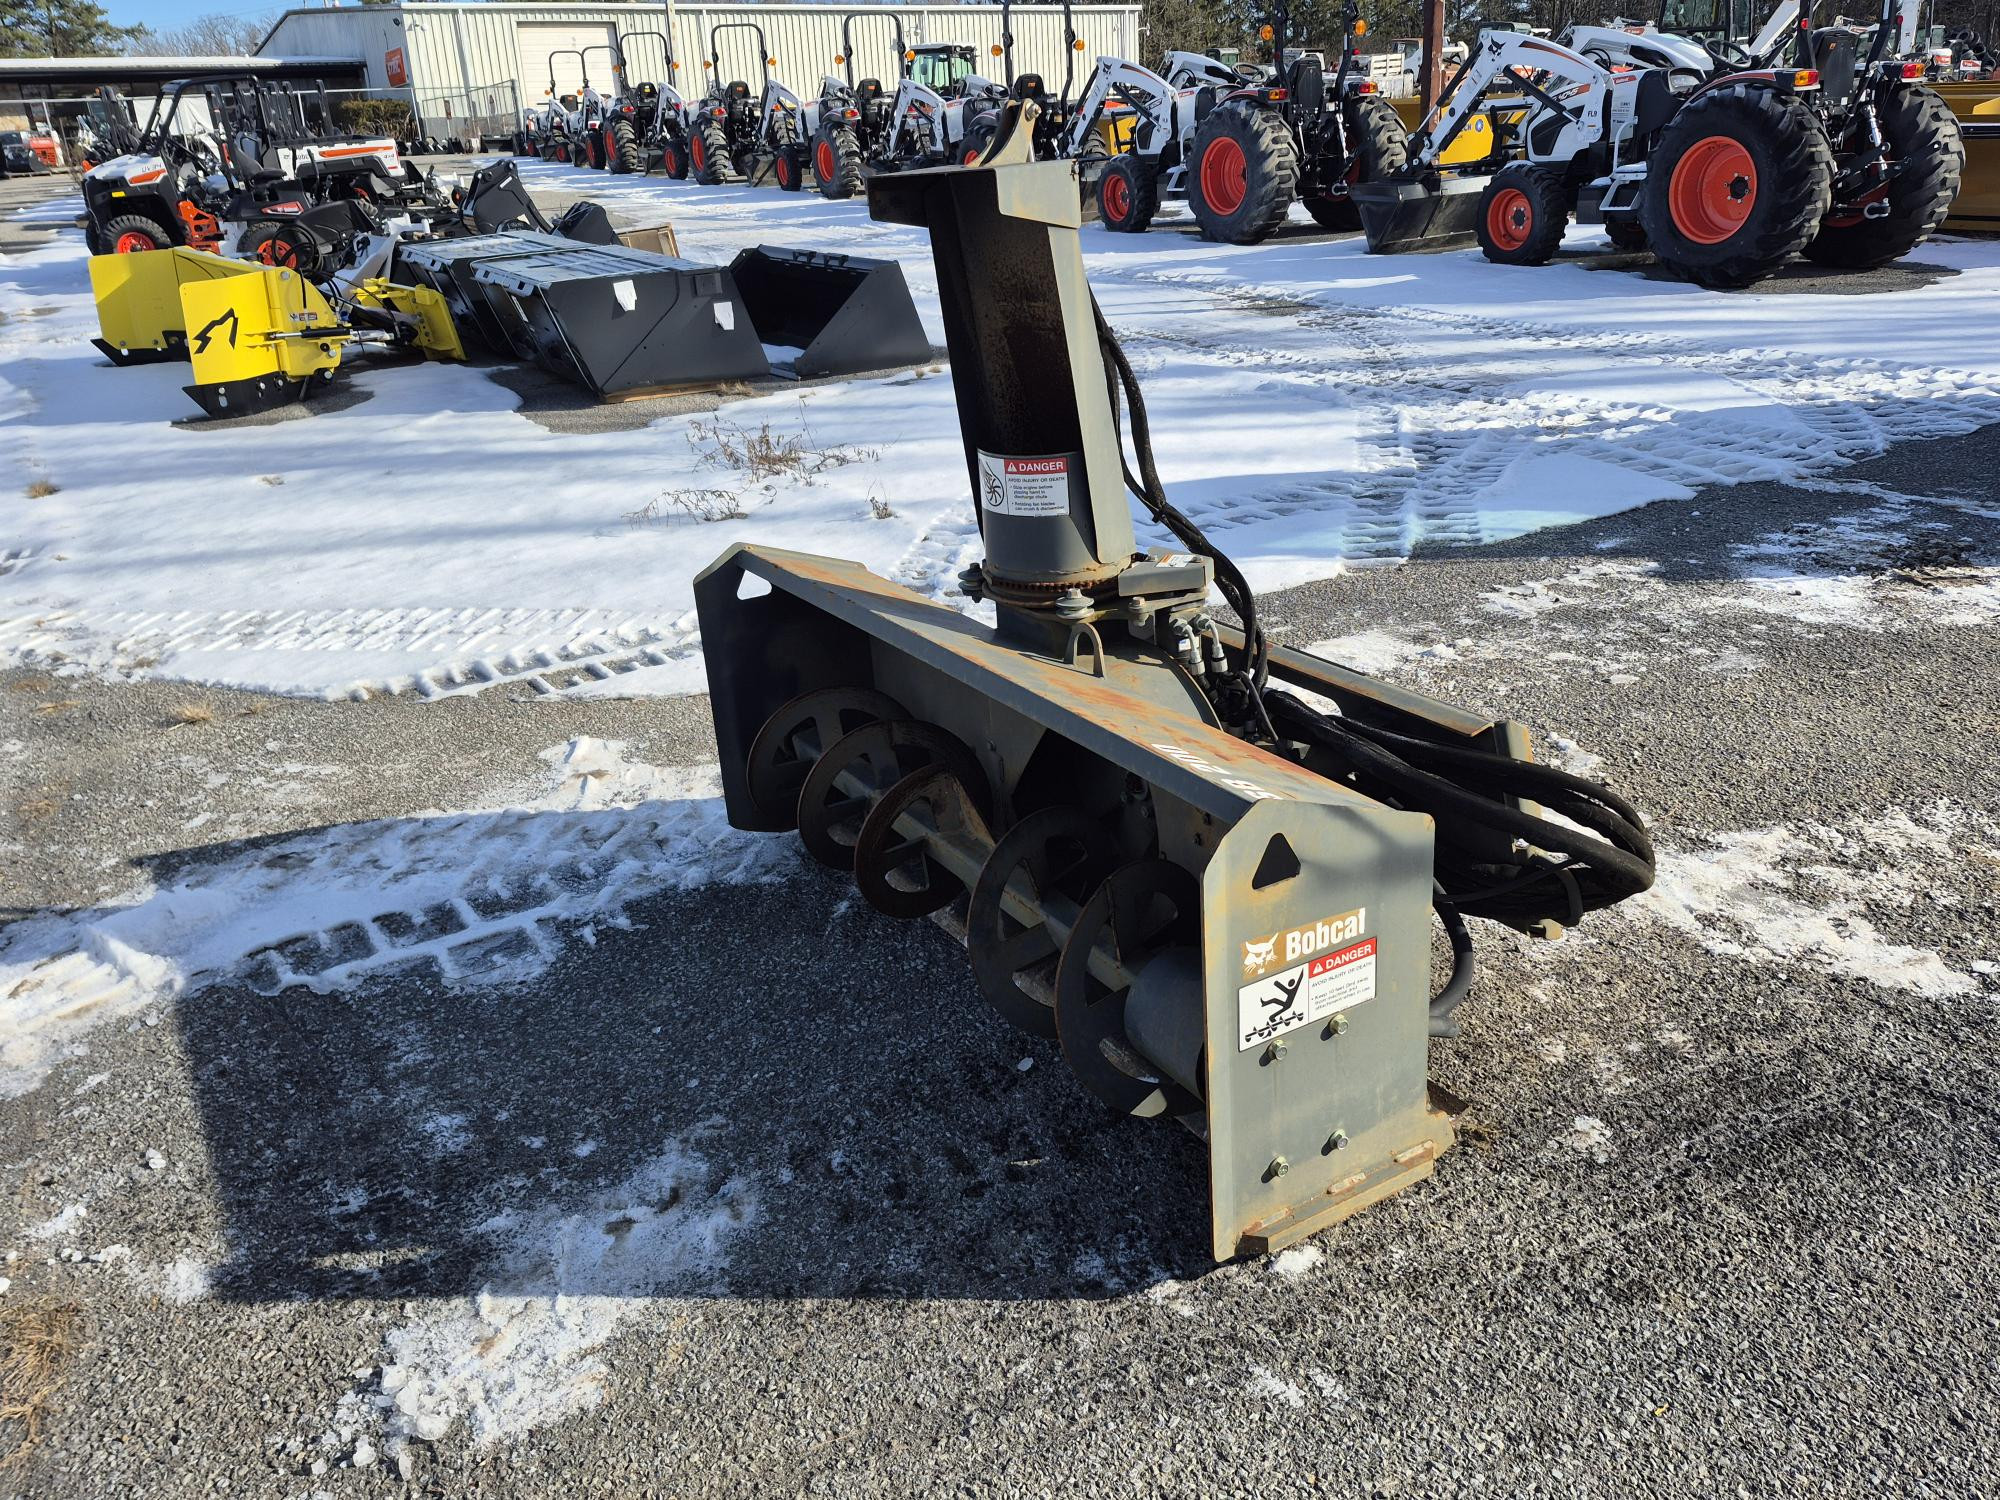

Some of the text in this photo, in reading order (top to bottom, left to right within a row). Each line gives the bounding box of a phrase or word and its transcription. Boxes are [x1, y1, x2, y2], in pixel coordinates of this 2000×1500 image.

[1019, 461, 1064, 472] DANGER
[1286, 907, 1366, 961] Bobcat
[1325, 944, 1372, 969] DANGER
